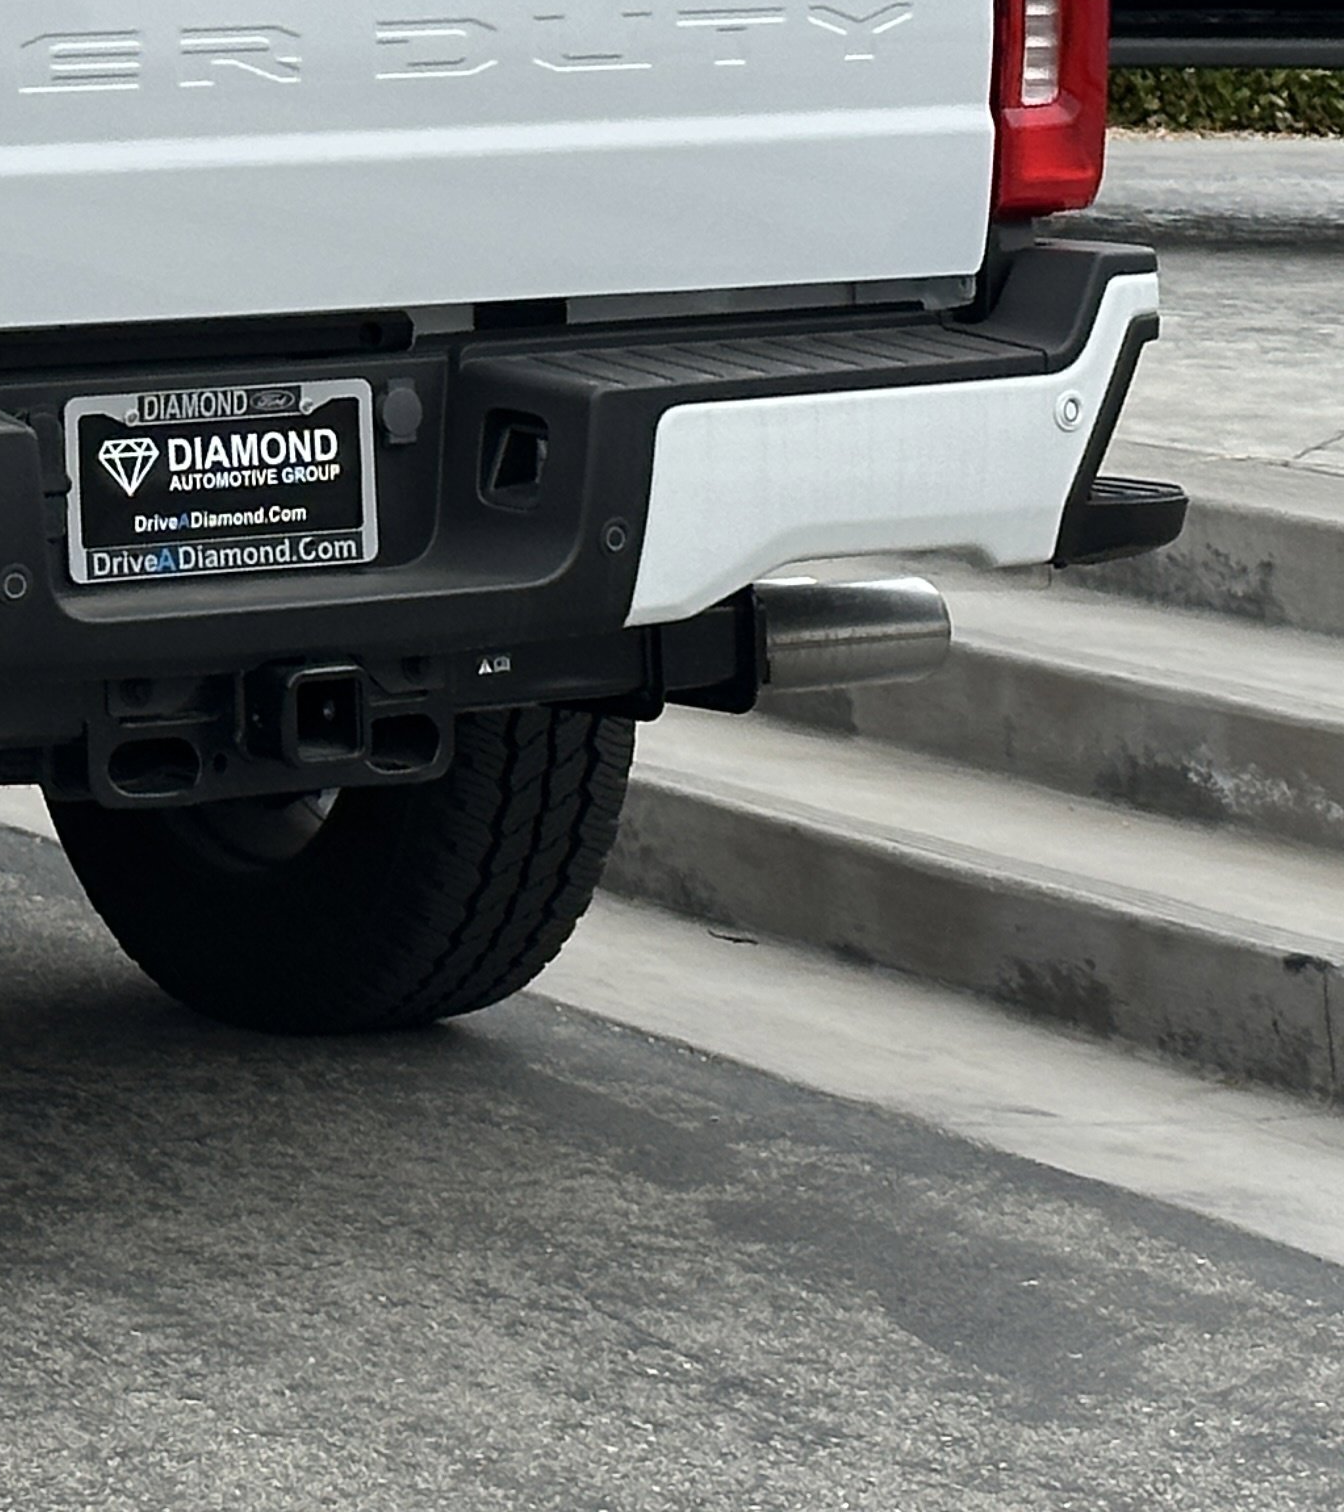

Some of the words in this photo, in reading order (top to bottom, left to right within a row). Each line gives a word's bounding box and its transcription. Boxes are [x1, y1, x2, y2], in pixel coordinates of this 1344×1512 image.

[375, 1, 913, 79] DUTY
[143, 390, 248, 421] DIAMOND
[168, 429, 338, 471] DIAMOND
[169, 467, 279, 491] AUTOMOTIVE
[281, 464, 341, 484] GROUP
[134, 505, 307, 533] DriveADiamond.Com
[92, 537, 357, 577] DriveADiamond.Com
